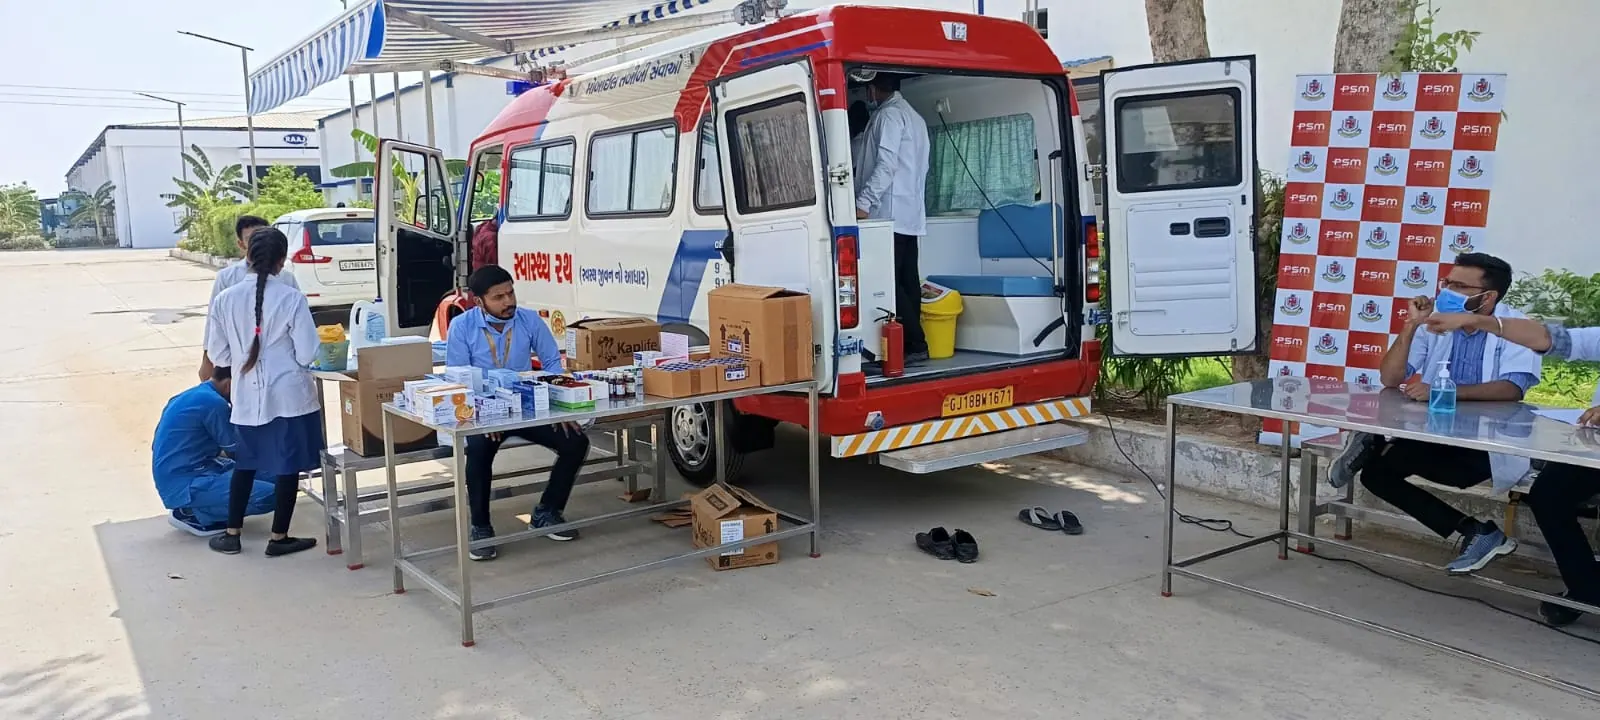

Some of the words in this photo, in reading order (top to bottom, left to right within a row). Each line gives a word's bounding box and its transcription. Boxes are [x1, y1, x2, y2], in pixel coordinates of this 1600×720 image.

[555, 252, 573, 285] રથ
[617, 338, 659, 355] Kaplife
[950, 389, 1011, 411] GJ18BW1671
